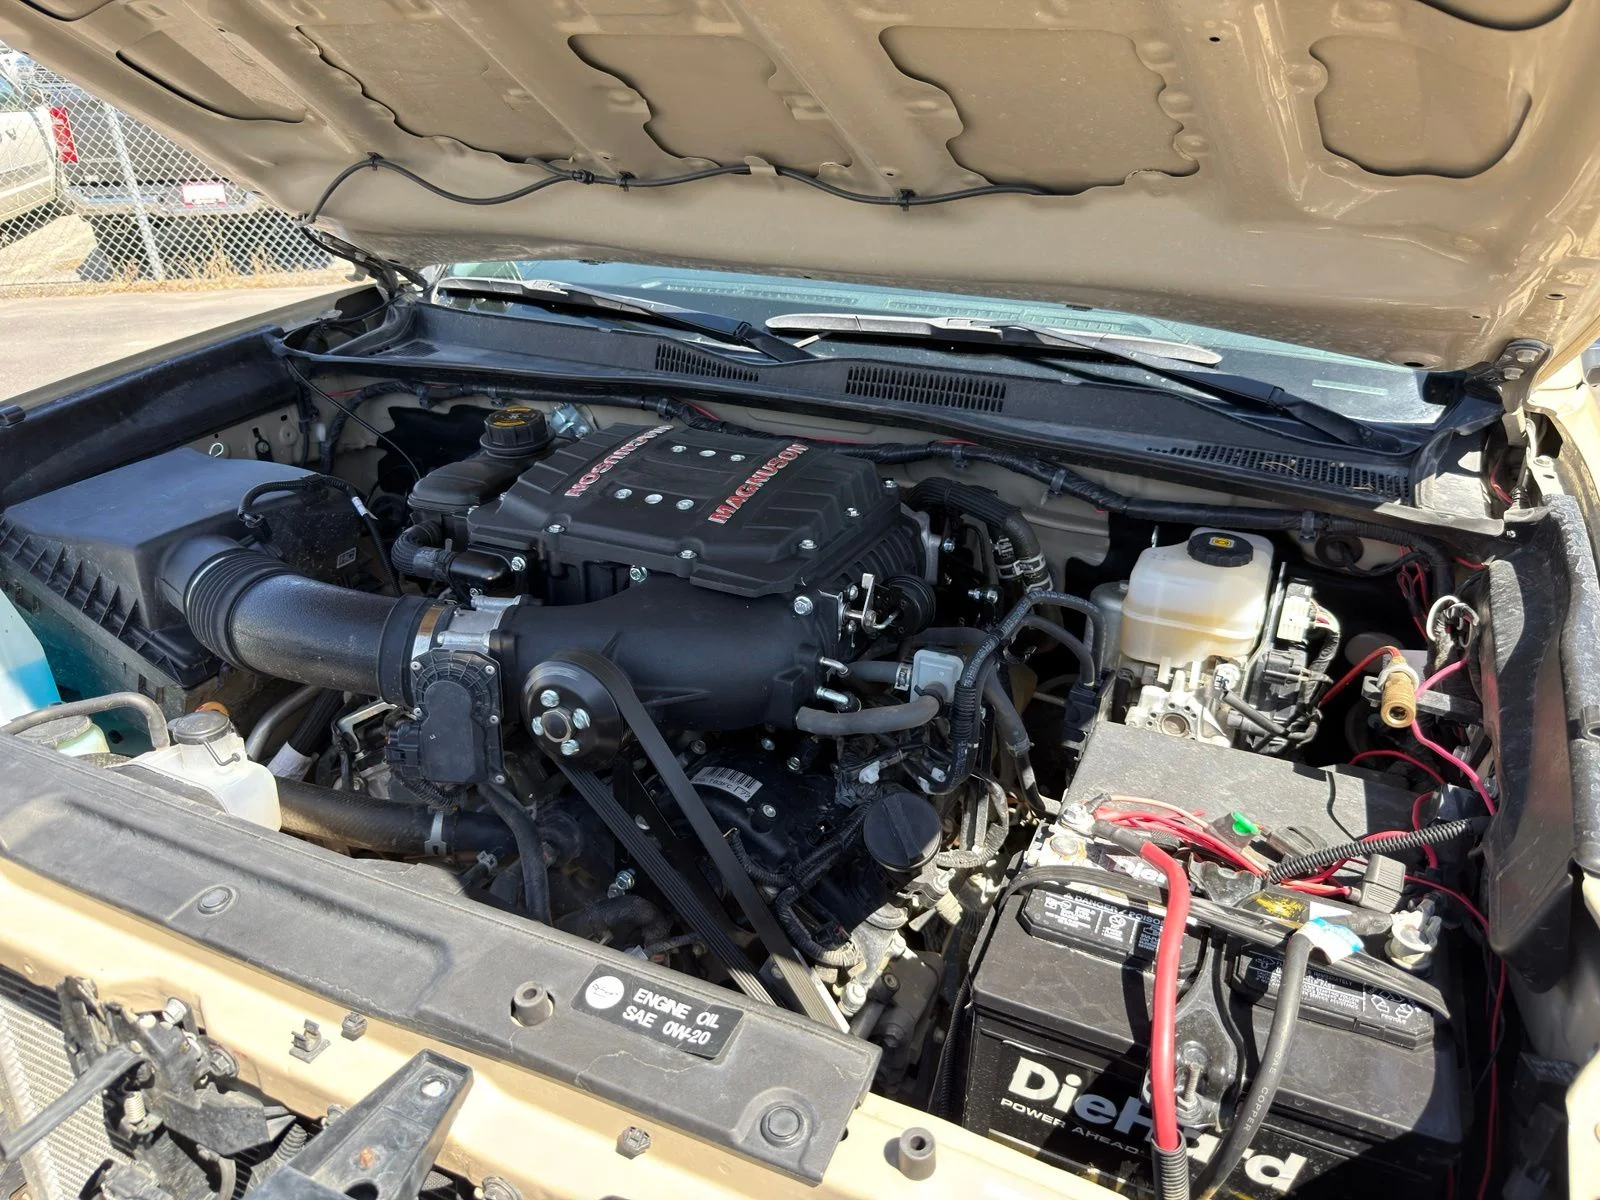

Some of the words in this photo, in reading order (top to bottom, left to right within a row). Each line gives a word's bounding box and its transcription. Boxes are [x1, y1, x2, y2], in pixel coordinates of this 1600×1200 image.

[708, 443, 809, 524] MAGNUSON
[1075, 895, 1118, 914] DANGER
[622, 1005, 658, 1028] SAE
[662, 1020, 712, 1045] 0W-20
[632, 988, 692, 1020] ENGINE
[695, 1011, 720, 1029] OIL
[1000, 1097, 1067, 1130] POWER
[1242, 1086, 1269, 1132] COPPER
